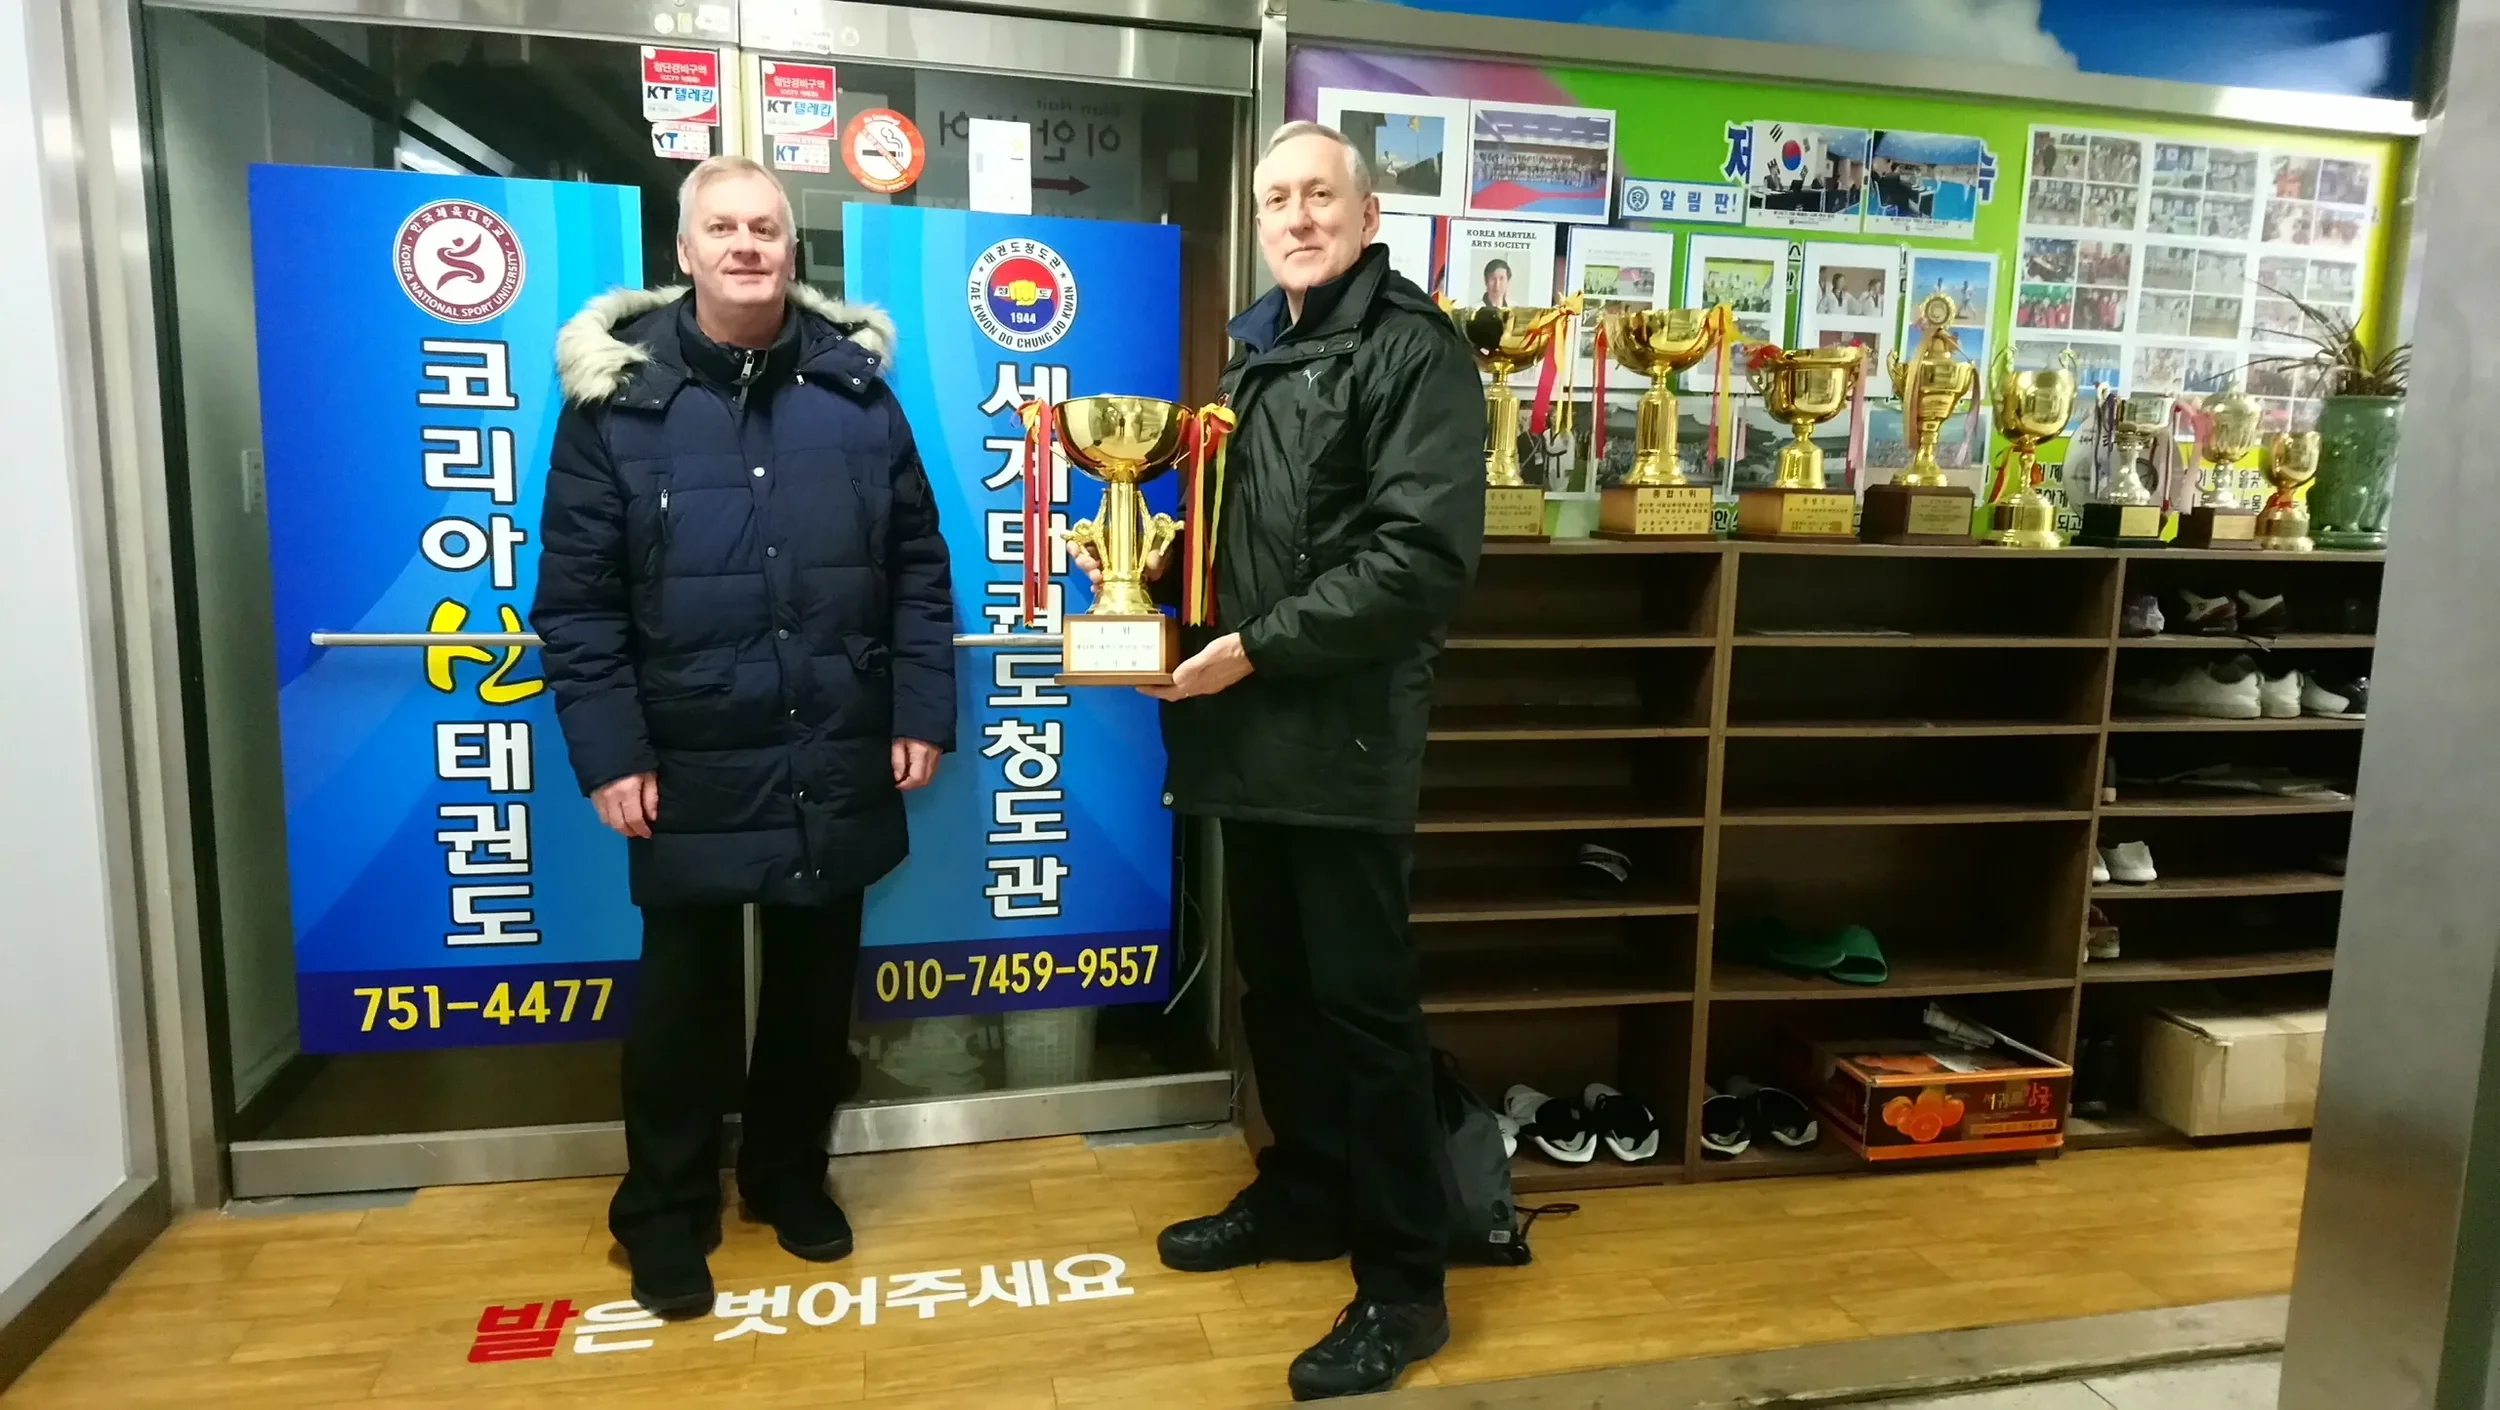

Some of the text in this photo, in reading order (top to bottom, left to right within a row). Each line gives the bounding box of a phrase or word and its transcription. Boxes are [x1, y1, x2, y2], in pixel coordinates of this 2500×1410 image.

[647, 85, 673, 100] KT
[767, 99, 792, 113] KT
[776, 144, 800, 162] KT
[409, 206, 505, 239] 한국체육대학교
[1466, 228, 1537, 240] KOREA MARTIAL
[1471, 239, 1531, 250] ARTS SOCIETY
[400, 243, 518, 317] KOREA NATIONAL SPORT UNIVERSITY
[970, 280, 1075, 348] TAE KWON DO CHUNG DO KWAN
[1010, 311, 1037, 325] 1944
[875, 944, 1160, 1003] 010-7459-9557
[353, 977, 614, 1032] 751-4477
[467, 1252, 1134, 1364] 발은 벗어주세요
